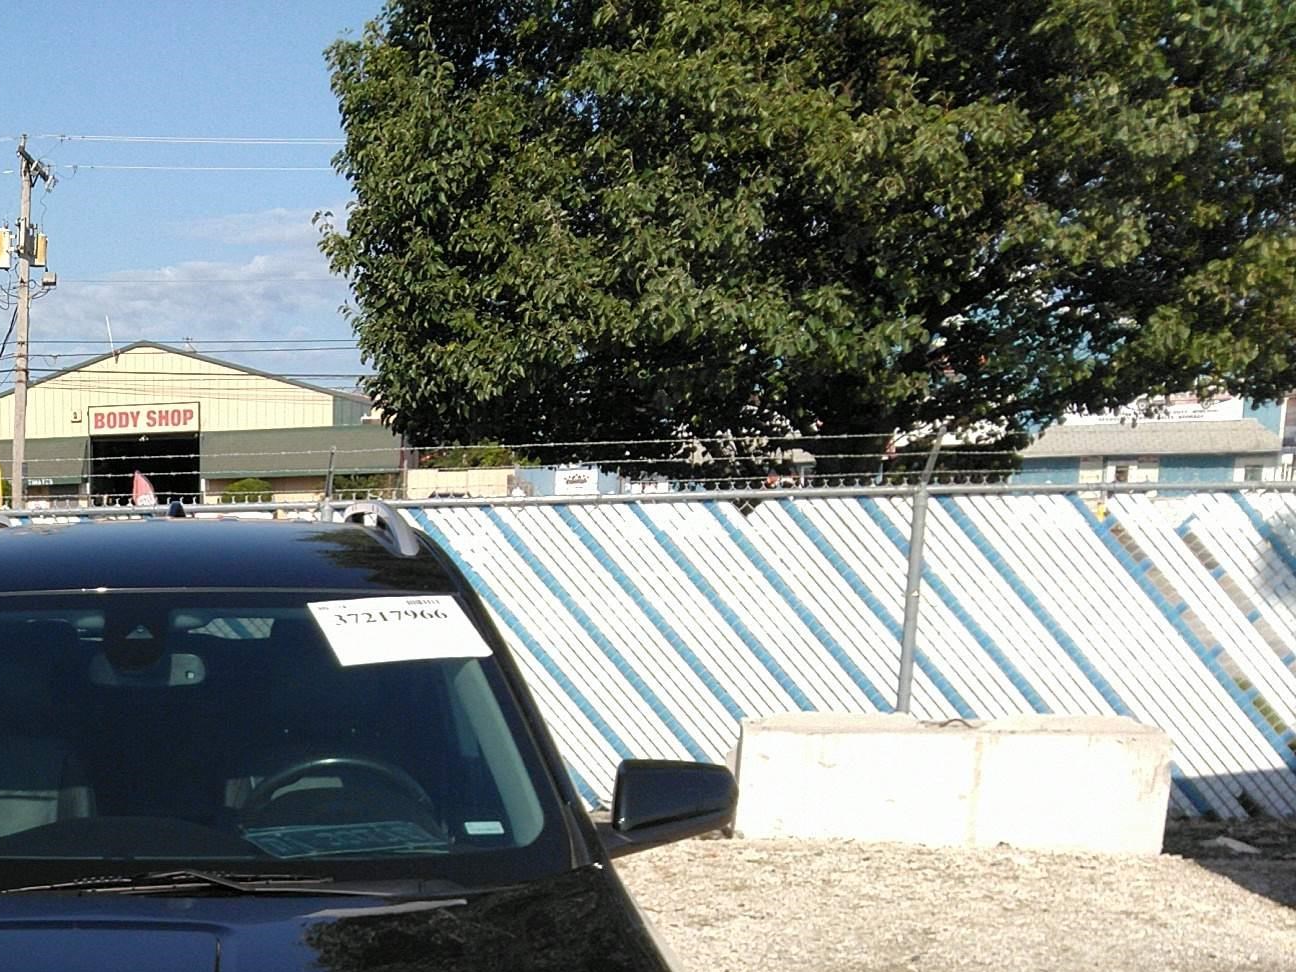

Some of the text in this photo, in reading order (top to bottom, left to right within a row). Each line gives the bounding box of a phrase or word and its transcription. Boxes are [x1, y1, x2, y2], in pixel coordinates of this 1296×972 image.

[94, 409, 194, 429] BODY SHOP
[335, 608, 448, 626] 37217966
